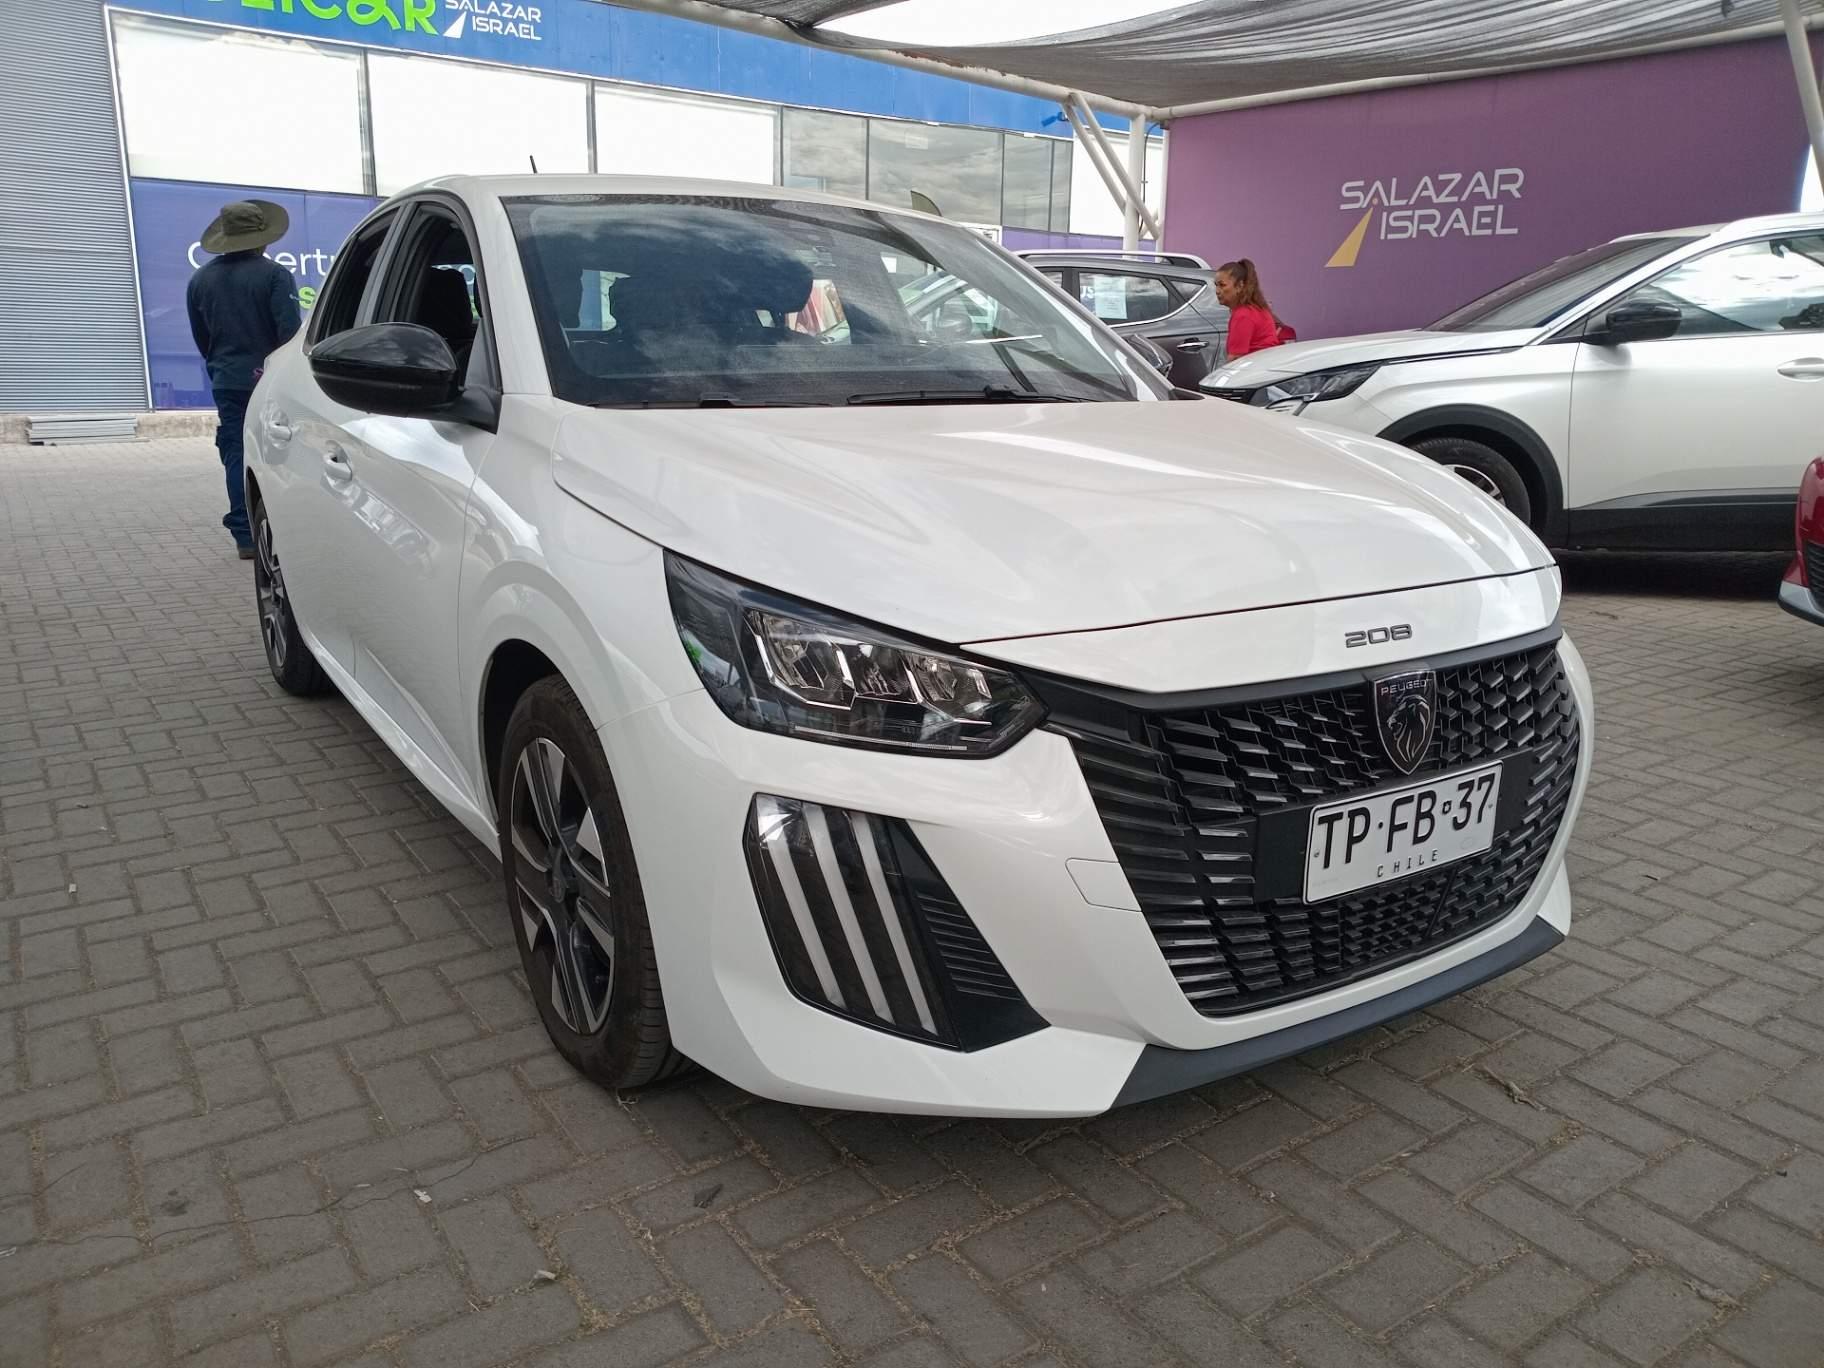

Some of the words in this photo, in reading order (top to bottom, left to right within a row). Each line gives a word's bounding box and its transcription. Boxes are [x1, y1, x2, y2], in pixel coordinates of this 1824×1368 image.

[445, 0, 542, 23] SALAZAR
[472, 16, 542, 40] ISRAEL
[1340, 168, 1525, 210] SALAZAR
[1380, 205, 1519, 240] ISRAEL
[1345, 624, 1412, 648] 208
[1377, 850, 1438, 878] CHILE
